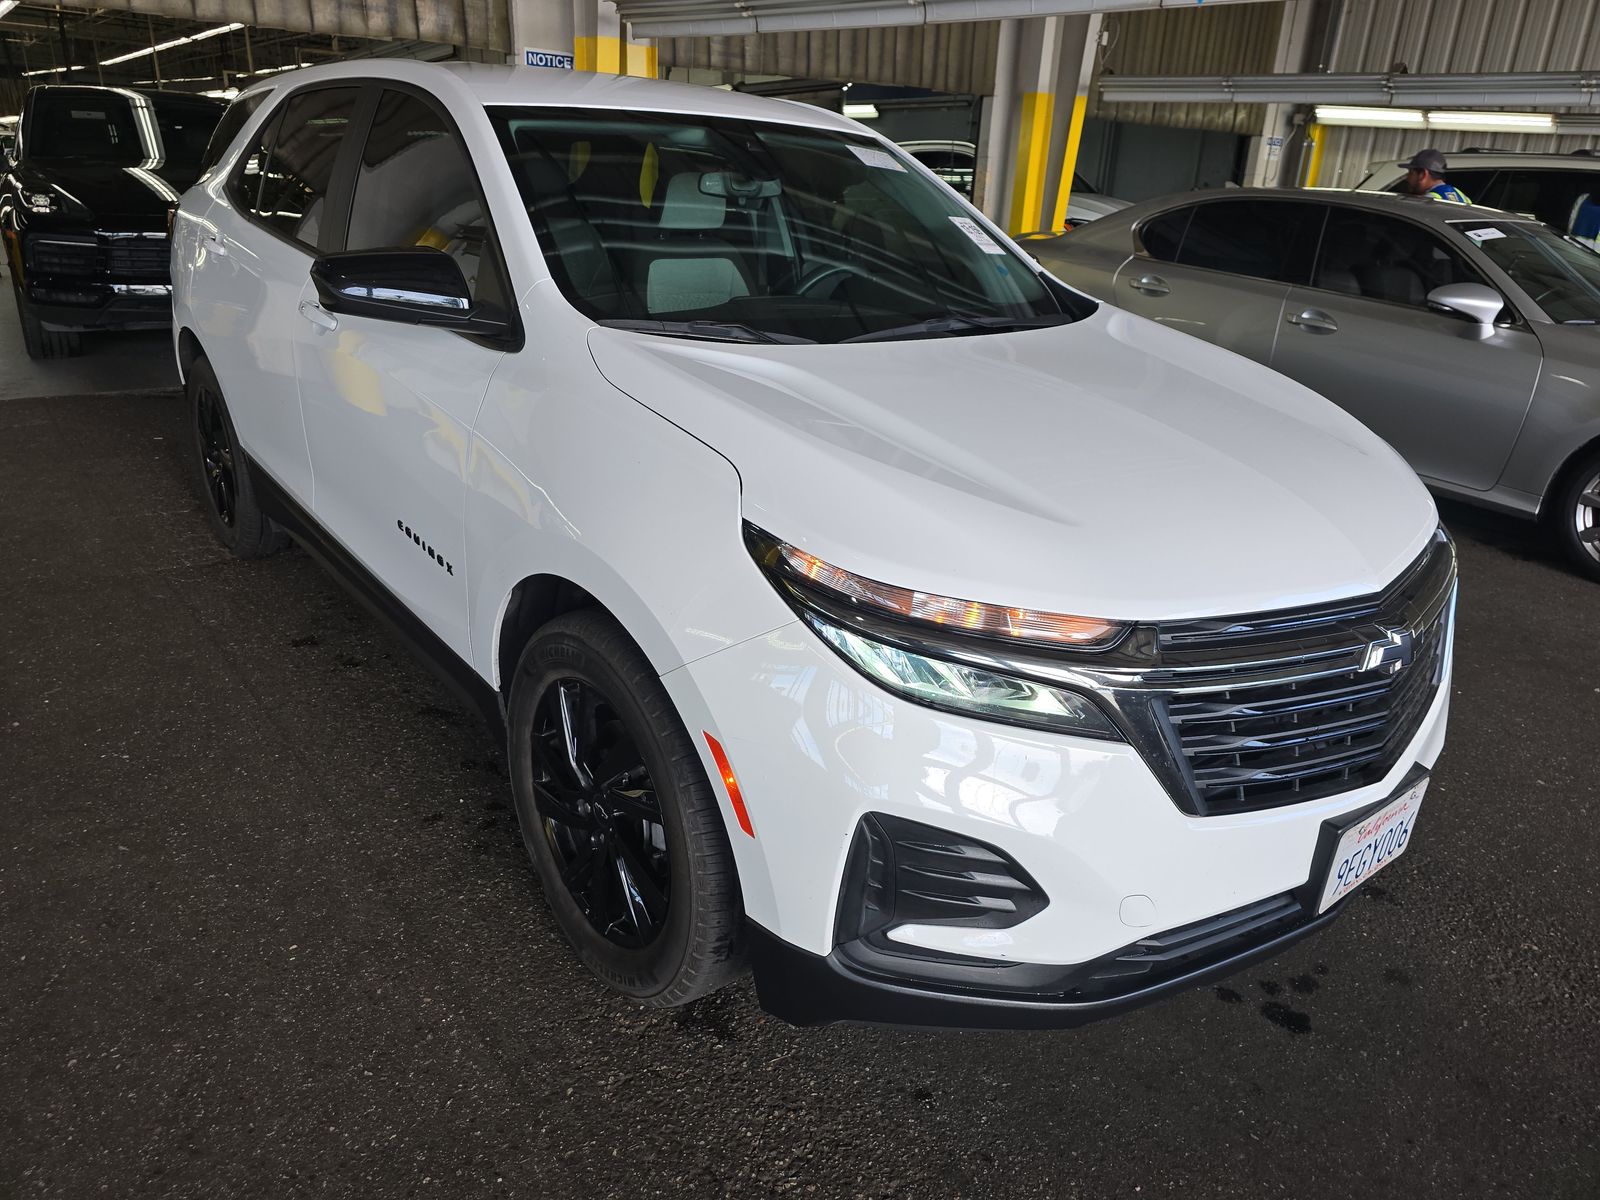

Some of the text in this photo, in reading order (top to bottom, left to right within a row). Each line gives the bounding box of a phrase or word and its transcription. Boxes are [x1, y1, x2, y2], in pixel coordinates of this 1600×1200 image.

[528, 53, 571, 69] NOTICE
[397, 519, 454, 577] EQUINOX
[1332, 811, 1415, 897] 9EGY006
